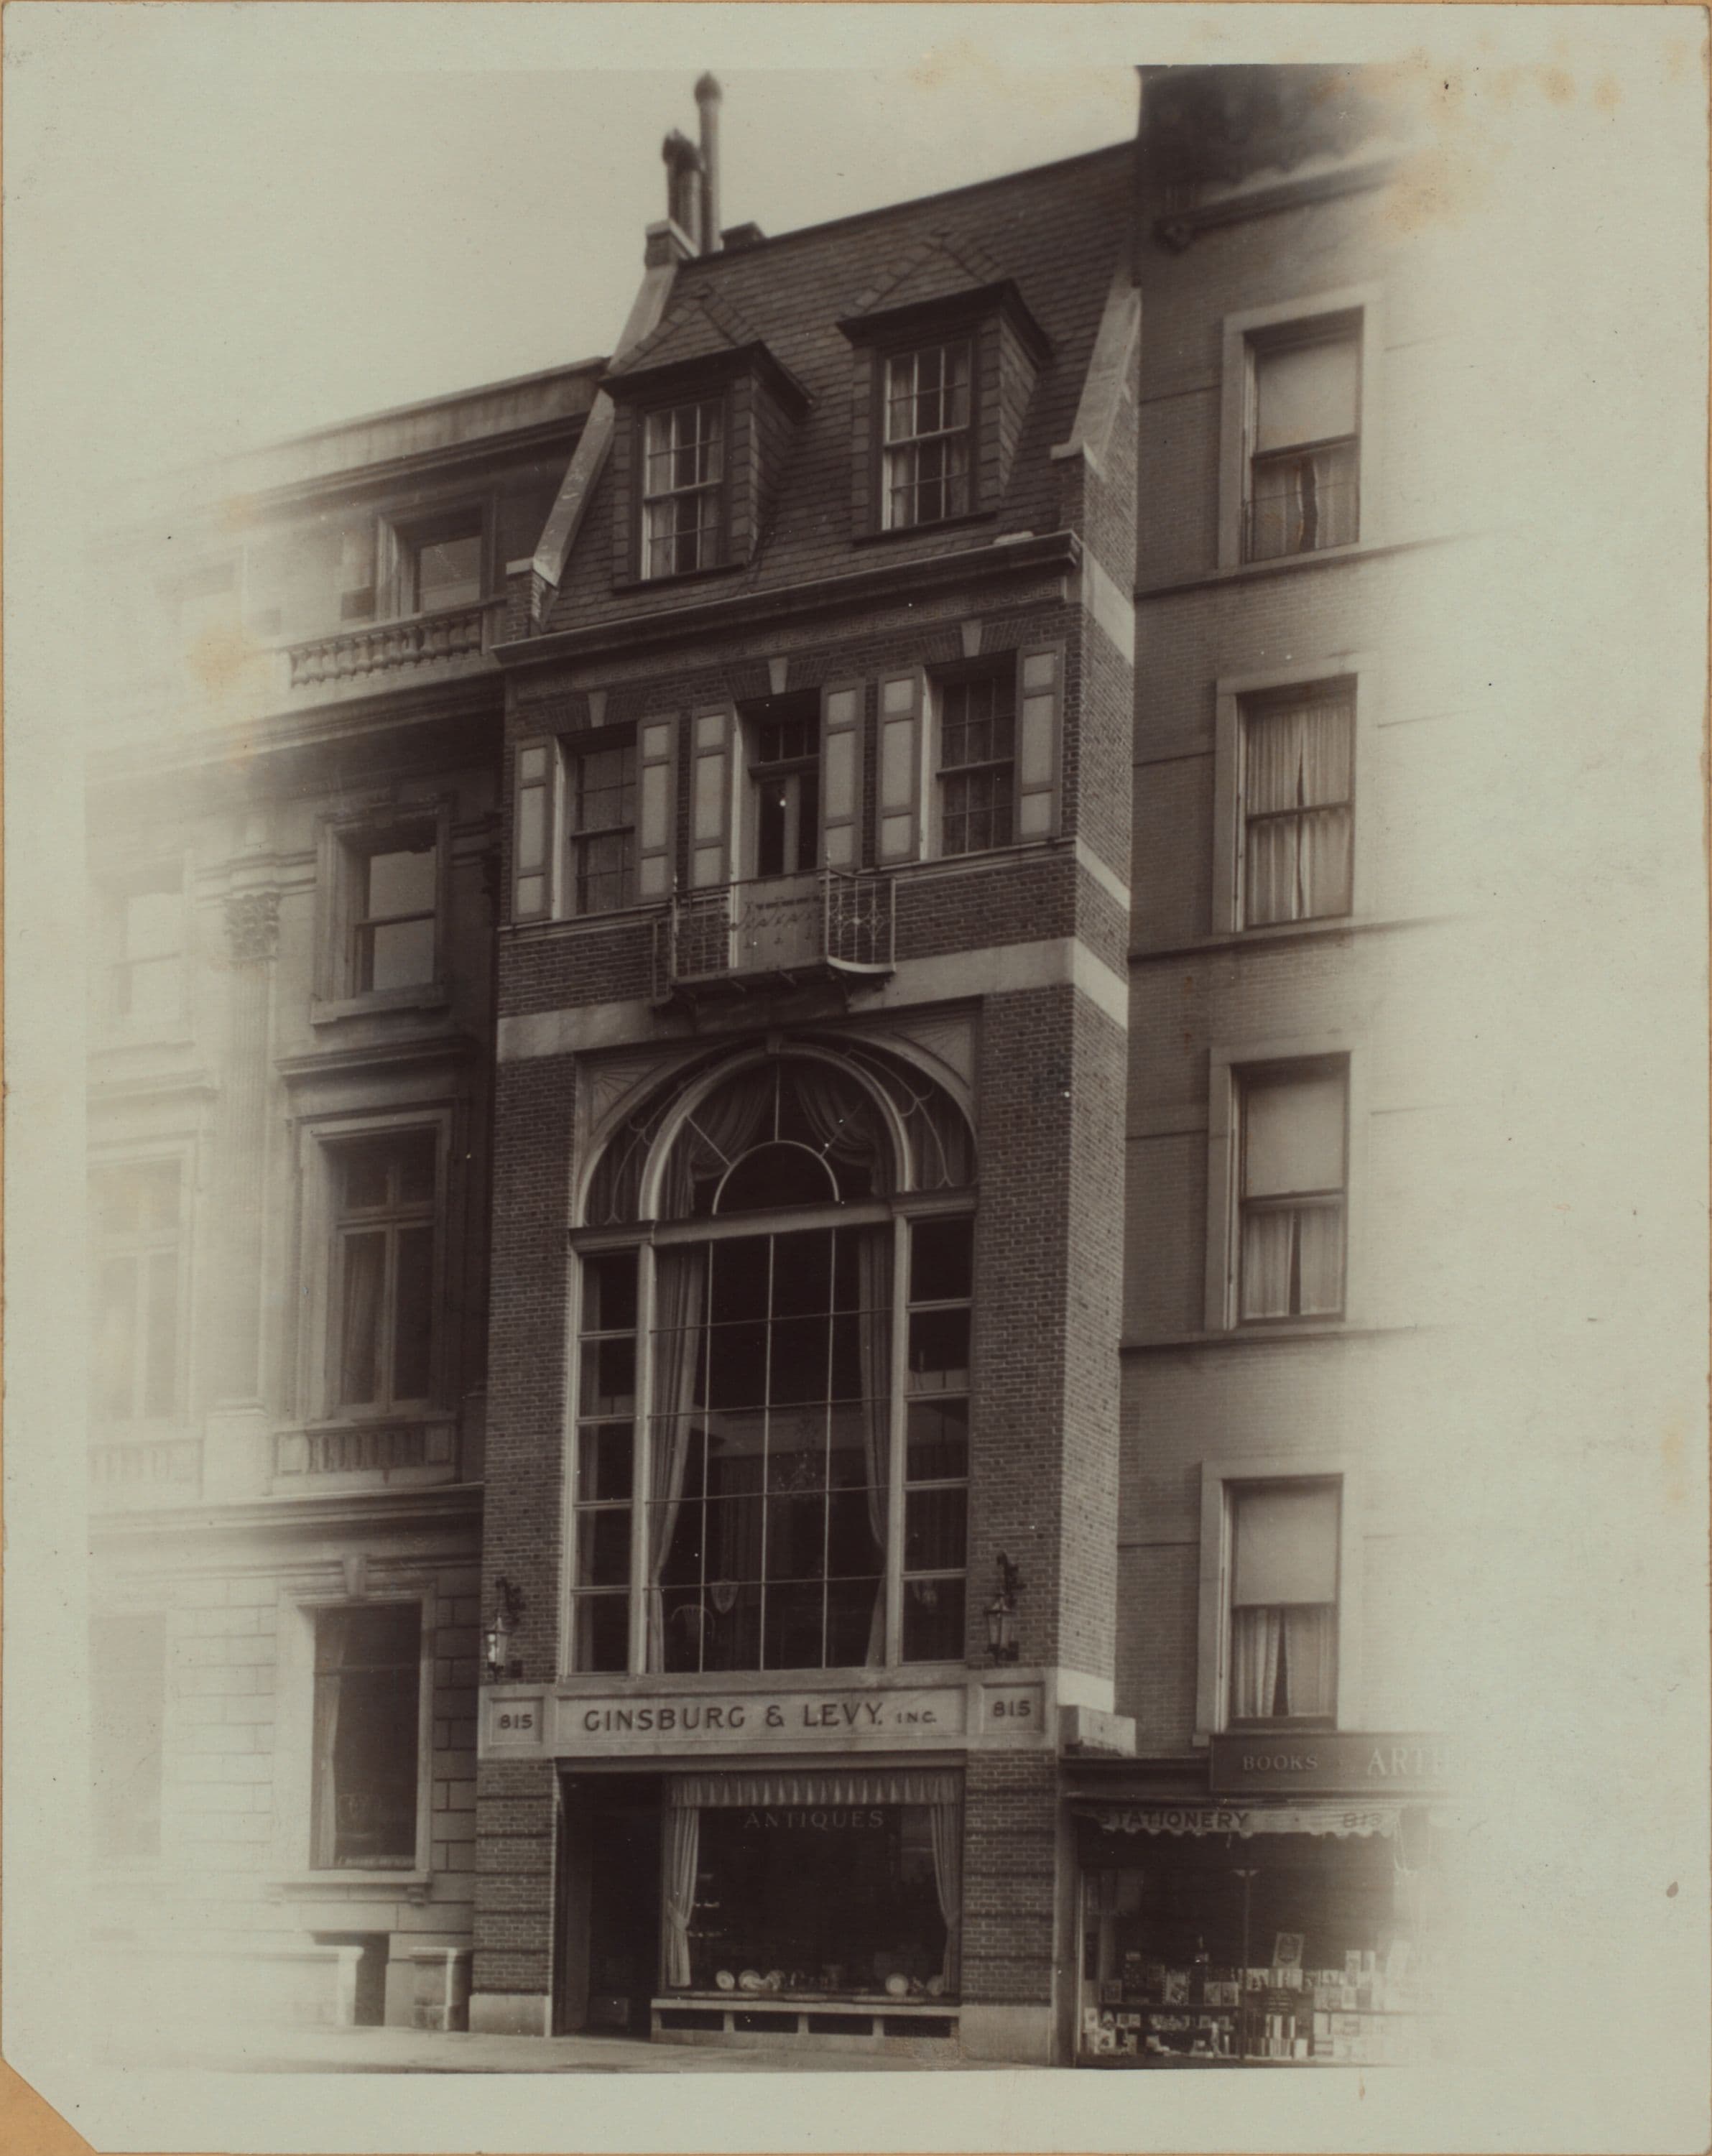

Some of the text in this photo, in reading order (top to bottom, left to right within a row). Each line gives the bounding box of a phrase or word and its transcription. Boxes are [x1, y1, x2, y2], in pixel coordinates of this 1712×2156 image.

[993, 1701, 1031, 1718] 815
[500, 1713, 533, 1729] 815
[583, 1706, 746, 1732] GINSBURG
[766, 1705, 784, 1727] &
[1243, 1755, 1318, 1772] BOOKS
[743, 1810, 885, 1831] ANTIQUES
[1098, 1810, 1249, 1828] STATIONERY
